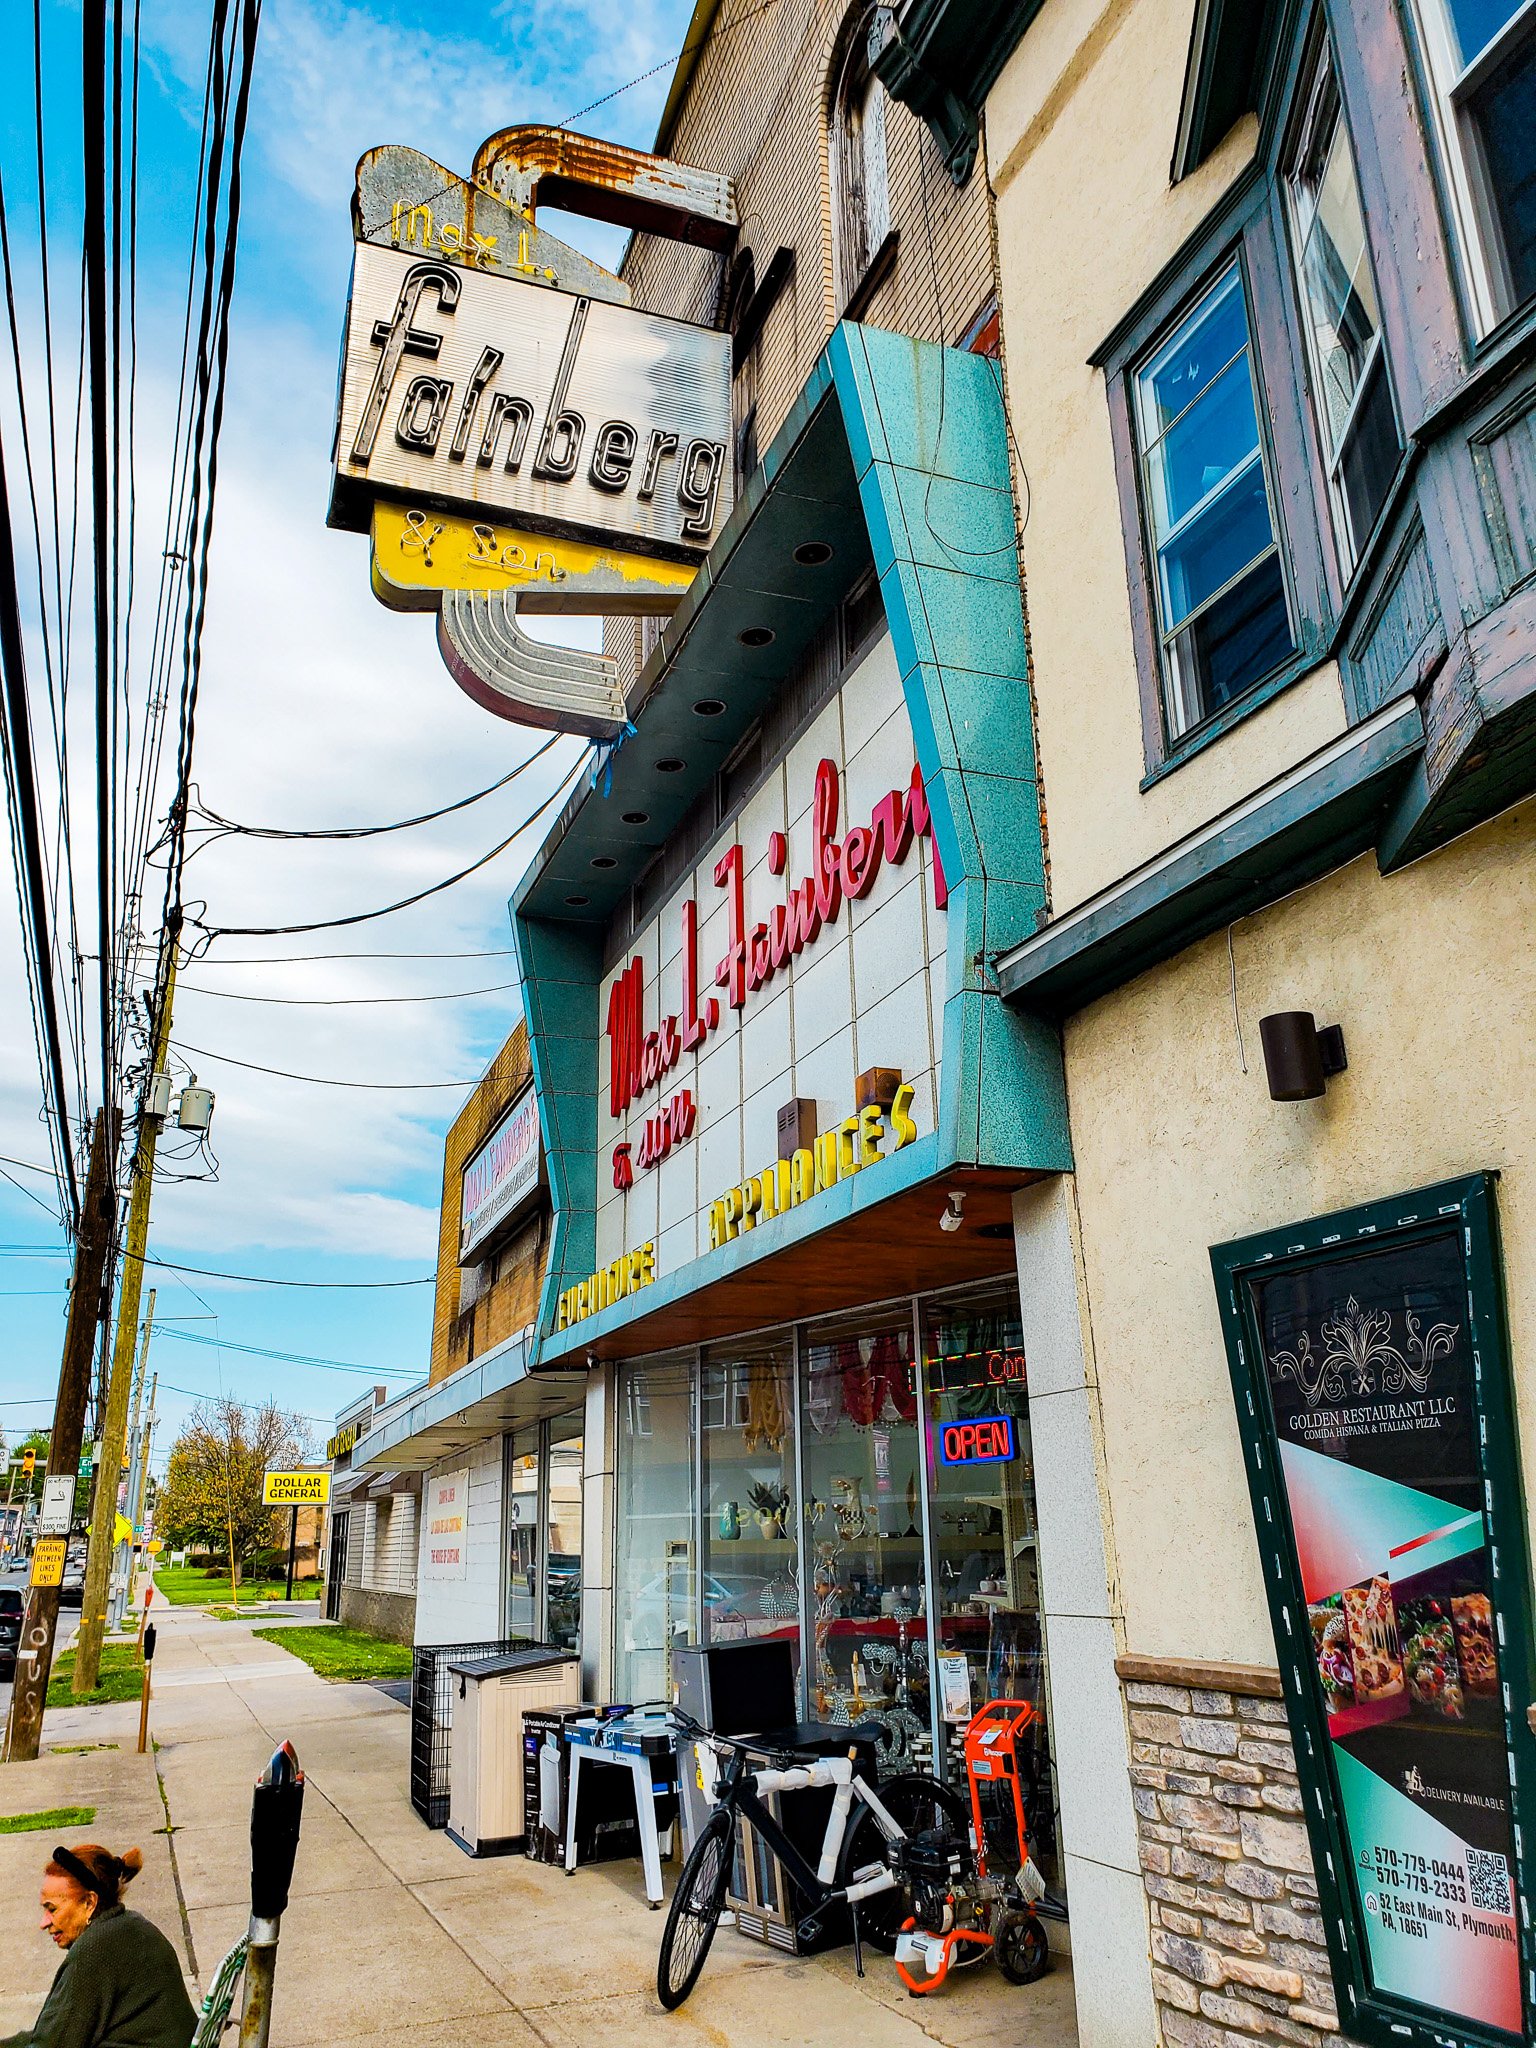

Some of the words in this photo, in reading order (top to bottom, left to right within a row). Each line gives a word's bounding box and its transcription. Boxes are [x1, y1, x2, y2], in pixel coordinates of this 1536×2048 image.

[349, 261, 727, 539] fainberg
[400, 509, 442, 567] &
[607, 955, 681, 1118] Max
[681, 899, 720, 1052] L.
[612, 1142, 633, 1190] &
[708, 1084, 917, 1250] APPLIANCES
[558, 1242, 655, 1331] FURNITURE
[1289, 1411, 1339, 1430] GOLDEN
[1343, 1401, 1425, 1424] RESTAURANT
[1429, 1397, 1456, 1415] LLC
[1304, 1429, 1334, 1440] COMIDA
[1337, 1425, 1369, 1437] HISPANA
[1371, 1425, 1378, 1433] &
[1379, 1420, 1414, 1433] ITALIAN
[1416, 1417, 1441, 1429] PIZZA
[944, 1421, 1009, 1460] OPEN
[269, 1488, 323, 1498] GENERAL
[273, 1478, 321, 1487] DOLLAR
[39, 1545, 62, 1553] PARKING
[1426, 1786, 1461, 1803] DELIVERY
[1463, 1793, 1505, 1811] AVAILABLE
[1374, 1846, 1465, 1882] 570-779-0444
[1376, 1867, 1467, 1903] 570-779-2333
[1379, 1893, 1391, 1910] 52
[1394, 1894, 1415, 1917] East
[1418, 1901, 1443, 1924] Main
[1446, 1909, 1460, 1931] St,
[1462, 1913, 1516, 1945] Plymouth,
[1382, 1912, 1397, 1933] PA,
[1399, 1917, 1428, 1939] 18651
